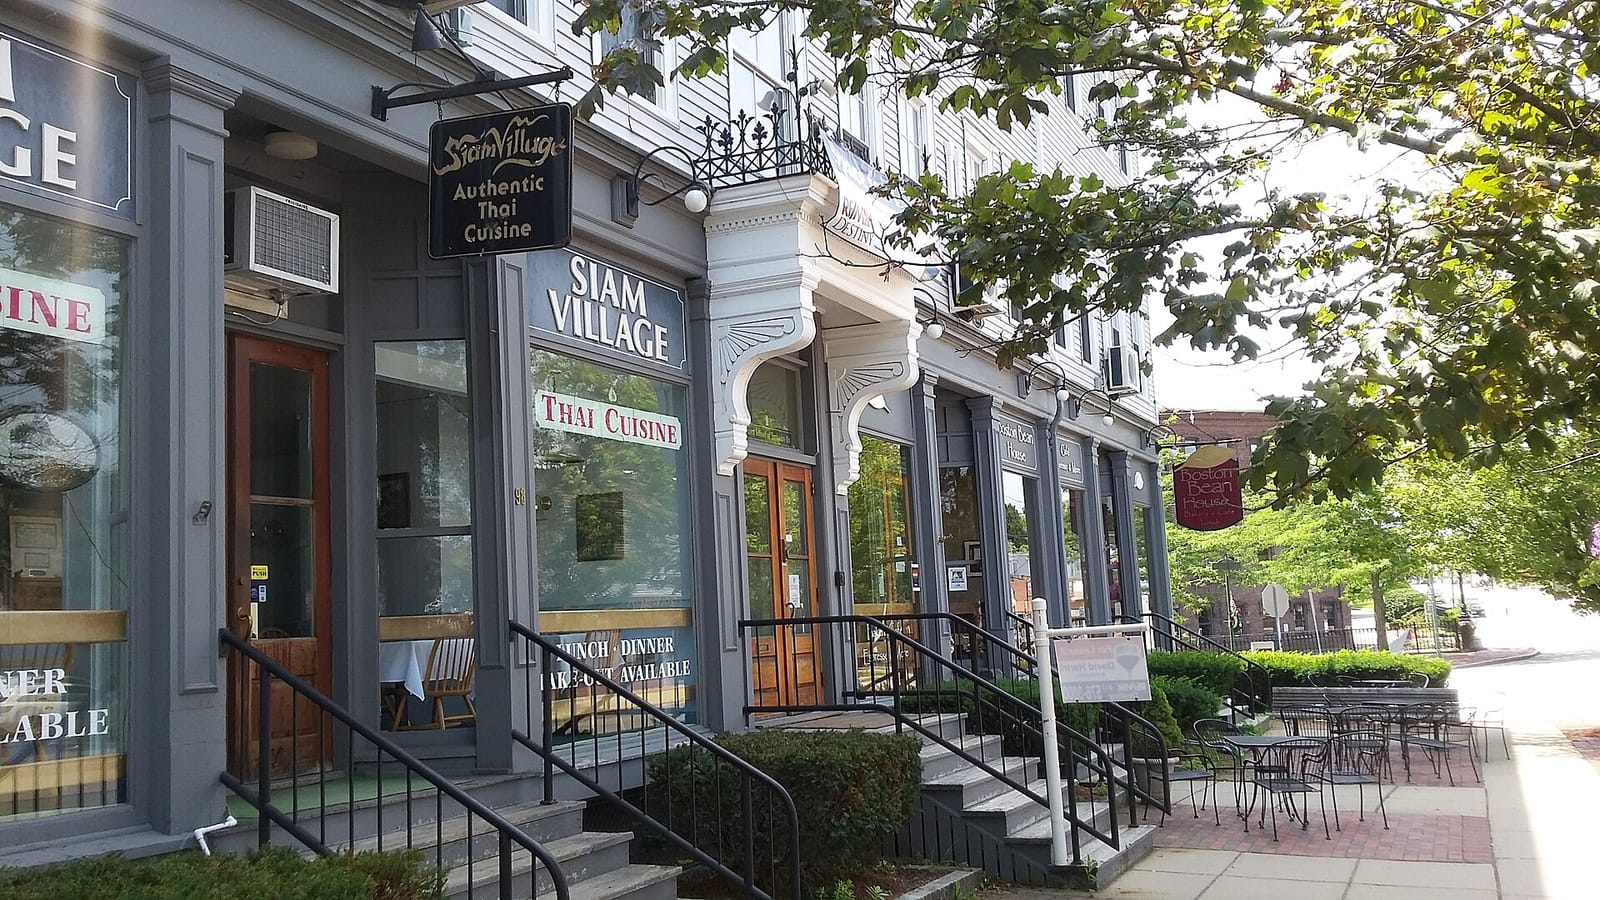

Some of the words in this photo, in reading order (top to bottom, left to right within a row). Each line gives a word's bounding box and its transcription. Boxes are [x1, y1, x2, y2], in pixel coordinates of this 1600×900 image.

[432, 129, 497, 176] Siam
[453, 174, 544, 200] Authentic
[478, 198, 517, 219] Thai
[464, 220, 532, 243] Cuisine
[833, 216, 875, 246] DESTINY
[570, 255, 648, 318] SIAM
[0, 285, 92, 334] INE
[547, 288, 669, 362] VILLAGE
[541, 394, 594, 429] THAI
[604, 408, 677, 444] CUISINE
[1017, 425, 1034, 445] Bean
[1007, 441, 1027, 463] House
[1181, 468, 1233, 481] Boston
[1188, 481, 1233, 496] Bean
[1183, 497, 1230, 509] House
[621, 637, 674, 656] DINNER
[620, 660, 691, 683] AVAILABLE
